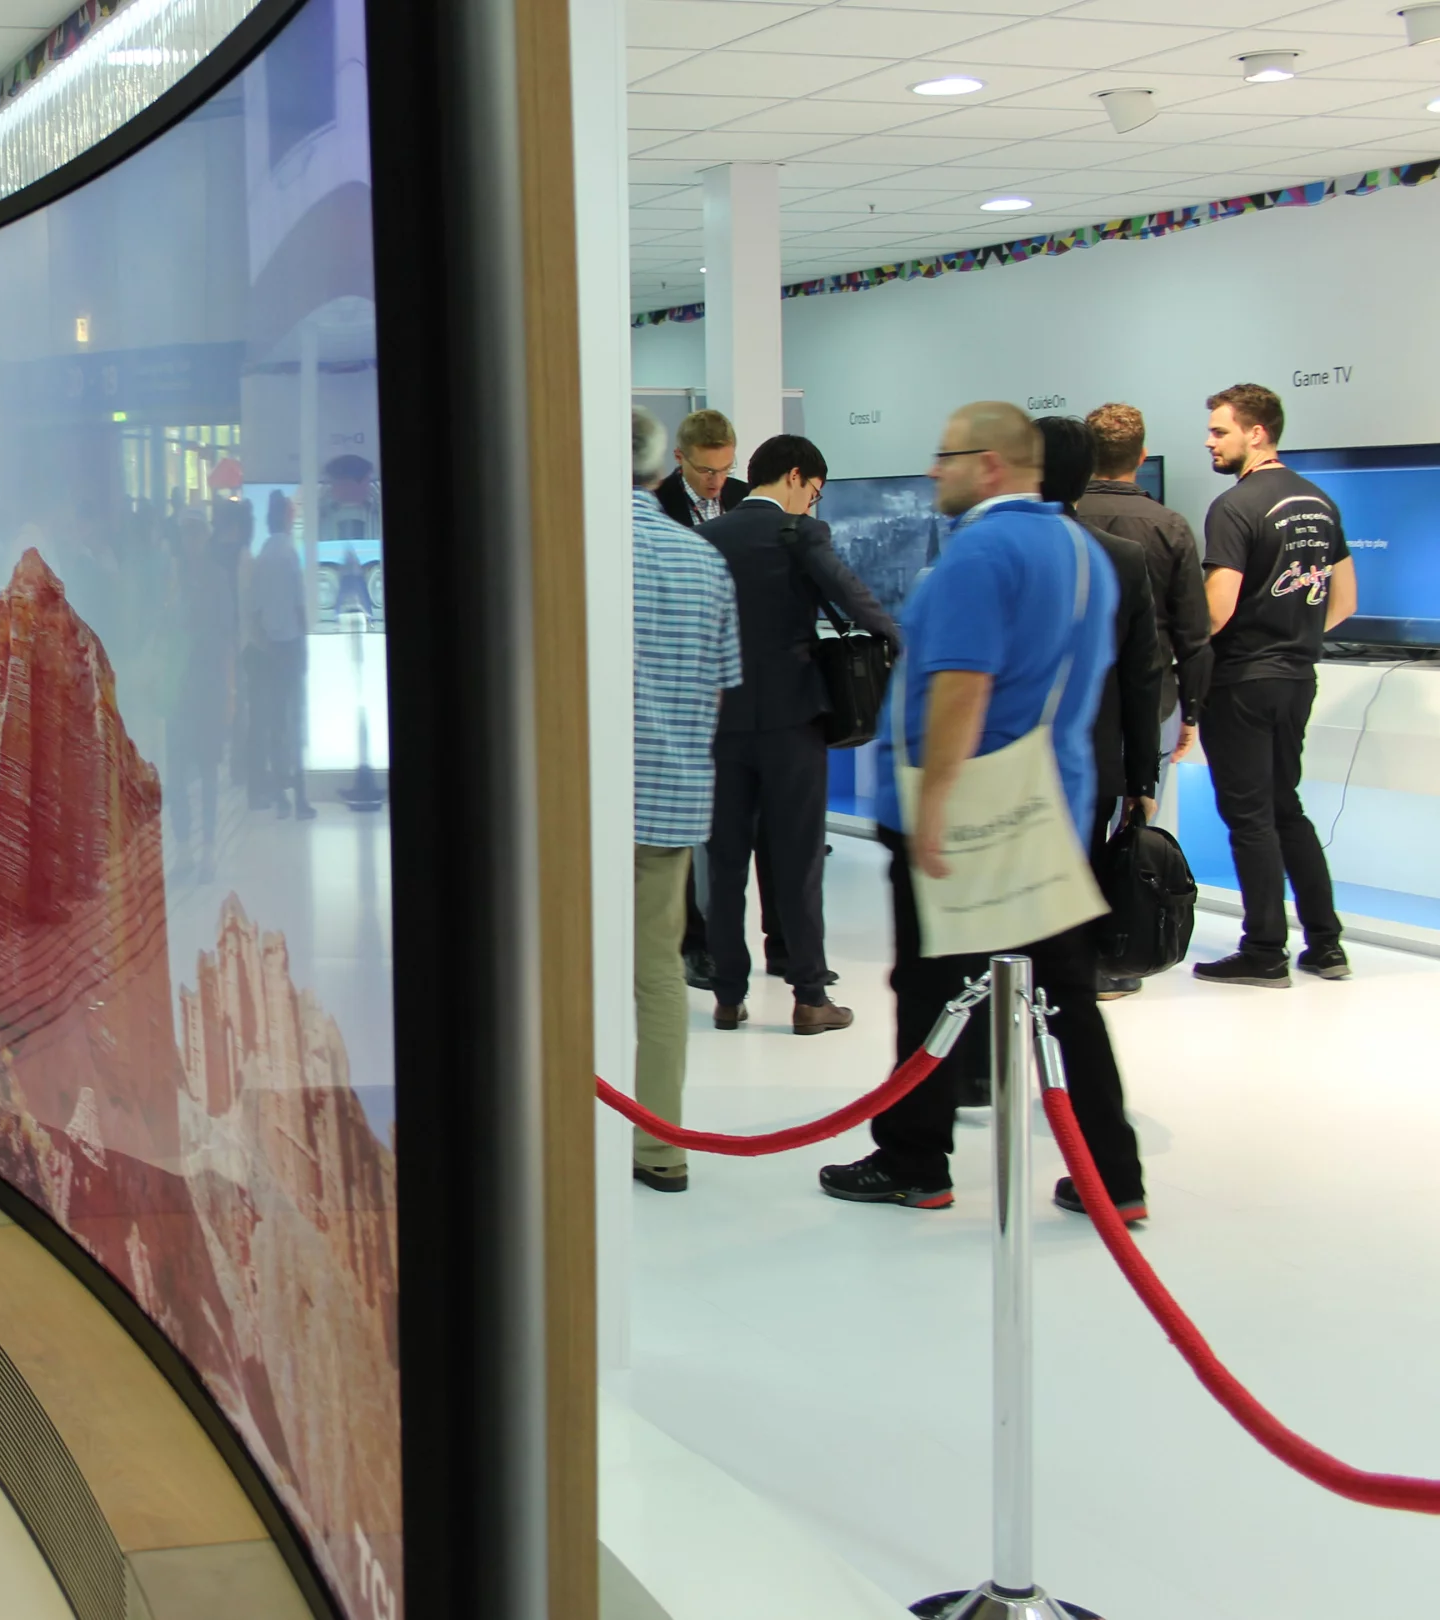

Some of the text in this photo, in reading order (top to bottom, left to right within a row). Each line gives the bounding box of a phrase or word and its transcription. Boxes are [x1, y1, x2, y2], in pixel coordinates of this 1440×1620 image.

[1293, 360, 1353, 387] Game TV
[1027, 394, 1067, 410] GuideOn
[849, 412, 870, 425] Cross
